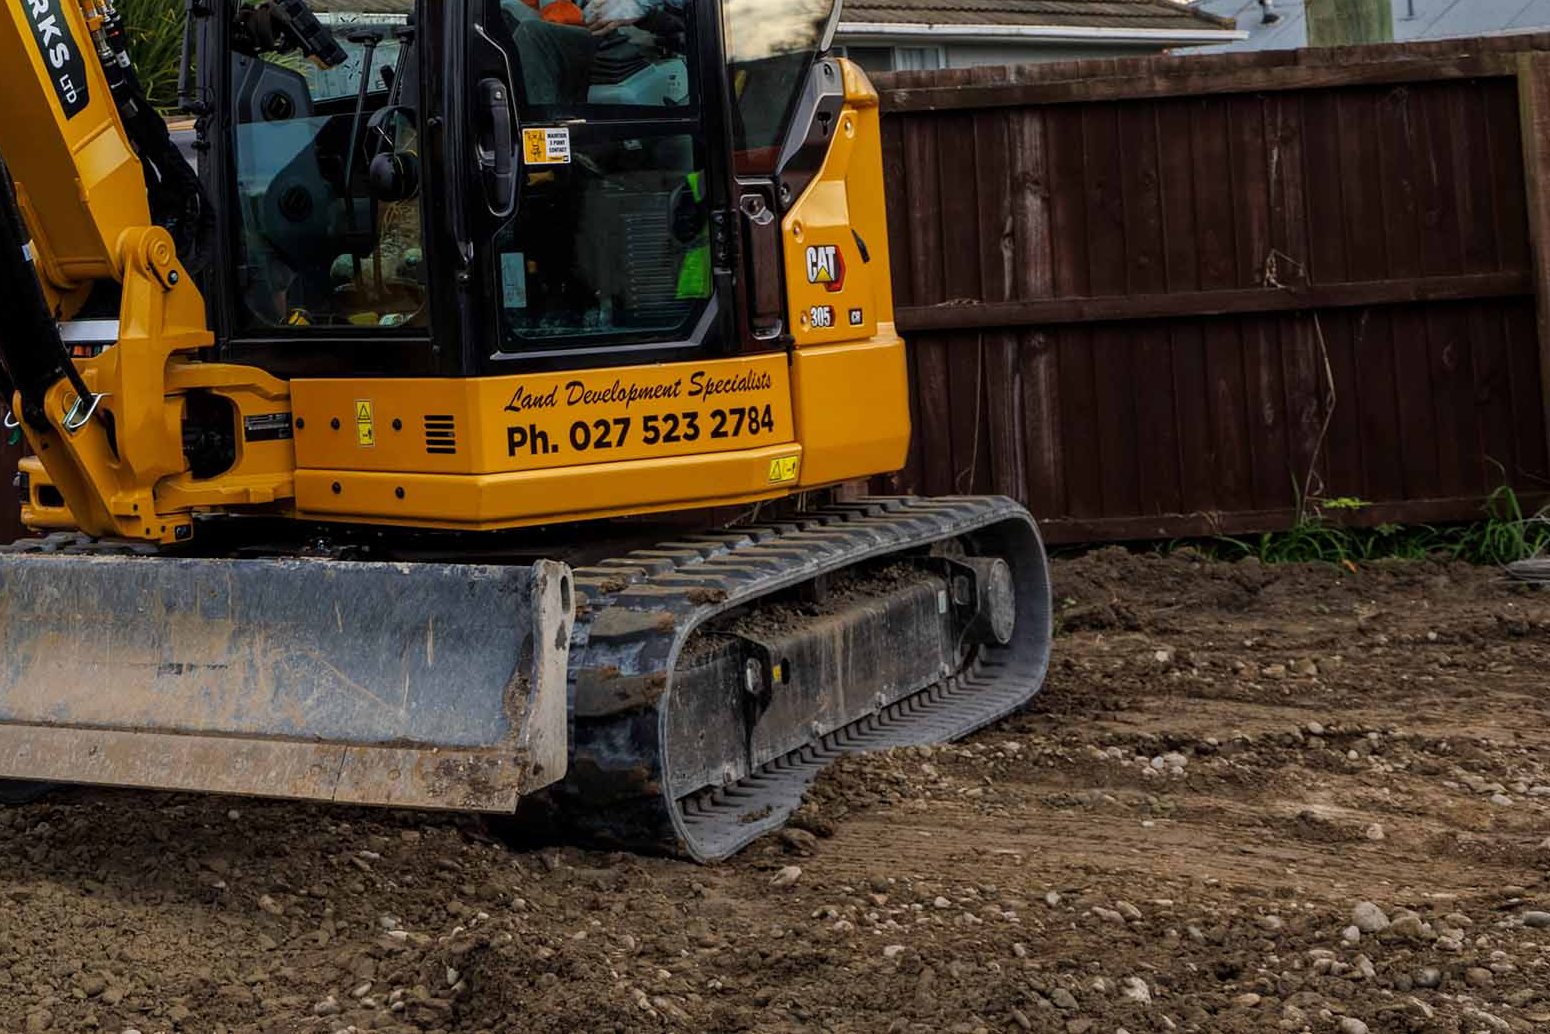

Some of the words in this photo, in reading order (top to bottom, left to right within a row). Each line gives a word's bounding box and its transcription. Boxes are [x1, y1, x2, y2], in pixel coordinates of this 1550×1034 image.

[59, 73, 77, 105] LTD
[806, 246, 836, 283] CAT
[811, 306, 831, 327] 305
[504, 384, 559, 413] Land
[565, 379, 682, 408] Development
[688, 368, 771, 403] Specialists
[507, 423, 559, 457] Ph.
[569, 417, 631, 452] 027
[642, 411, 700, 445] 523
[709, 403, 775, 439] 2784
